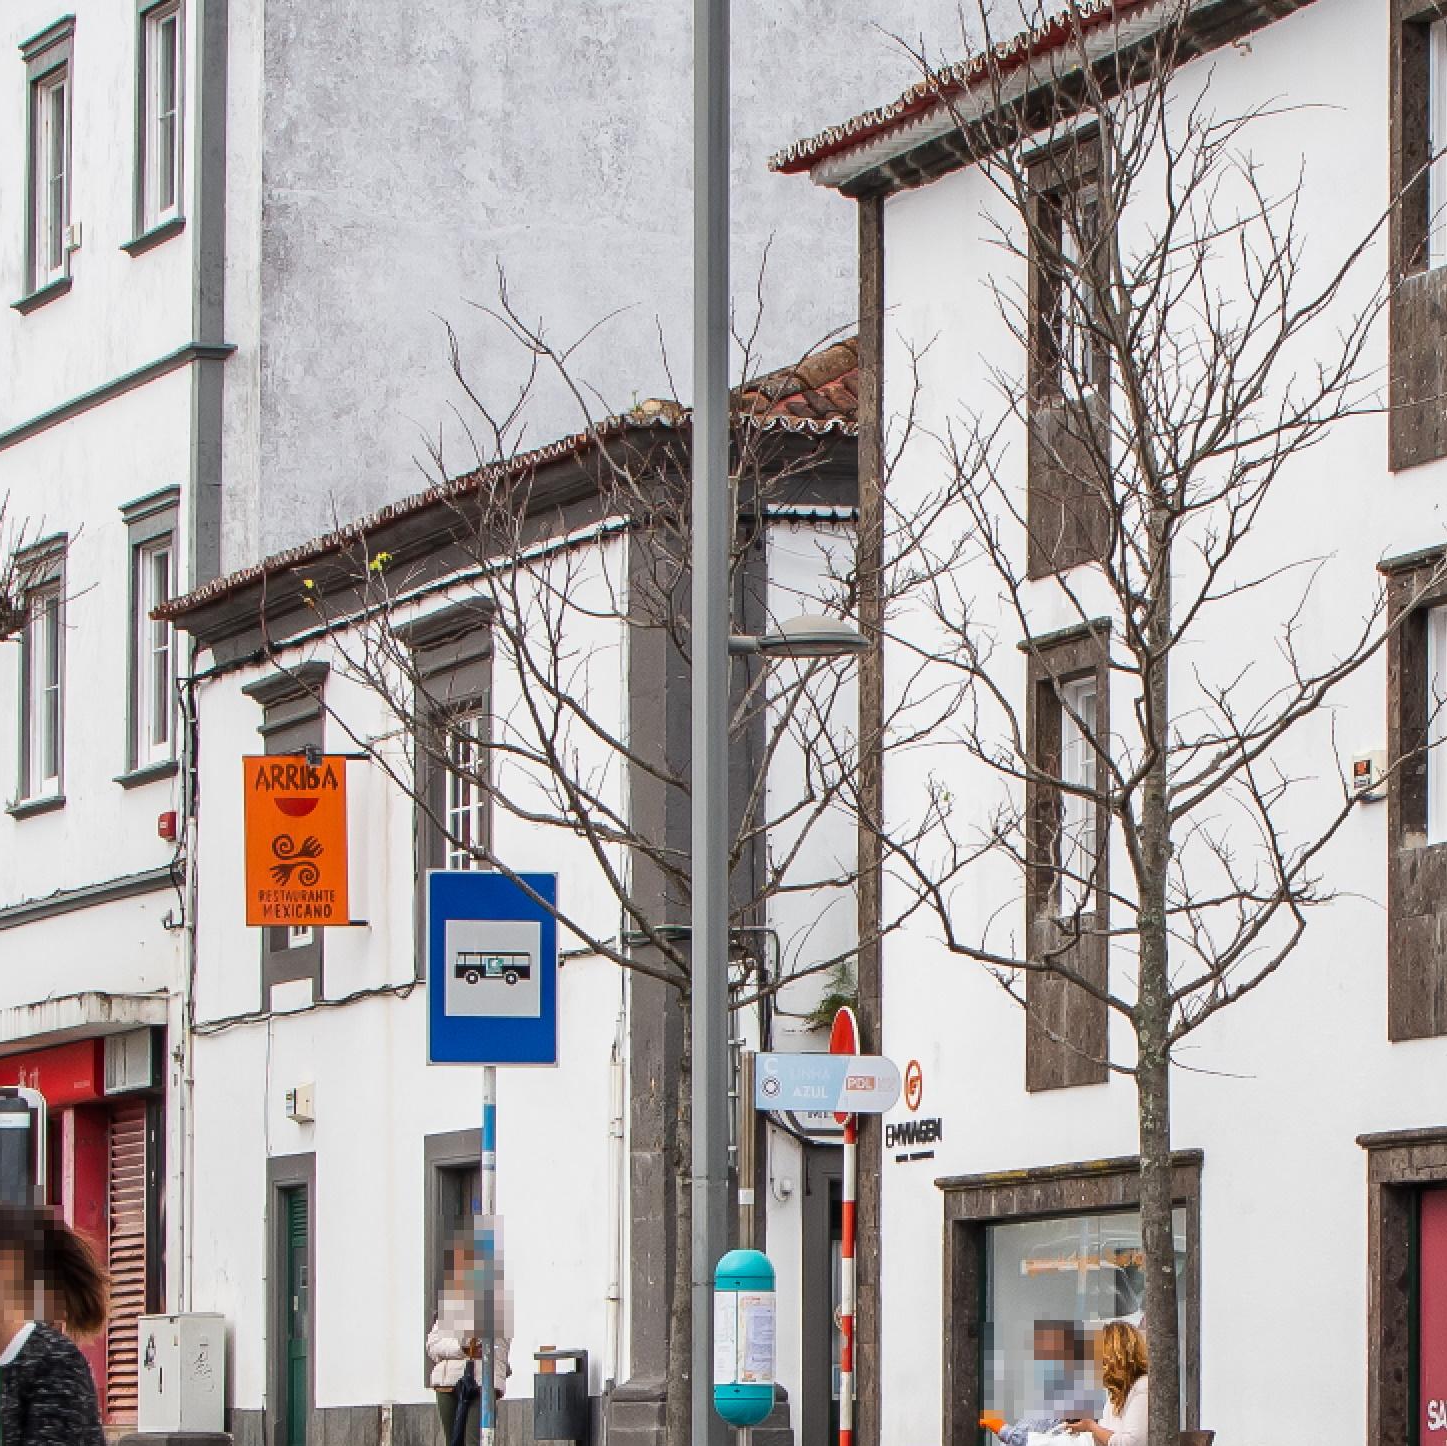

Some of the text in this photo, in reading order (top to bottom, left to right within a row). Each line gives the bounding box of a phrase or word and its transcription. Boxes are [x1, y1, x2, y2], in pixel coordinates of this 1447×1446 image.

[255, 764, 339, 792] ARRIBA
[258, 889, 335, 902] RESTAURANTE
[263, 904, 333, 919] MEXICANO
[792, 1085, 829, 1099] AZUL
